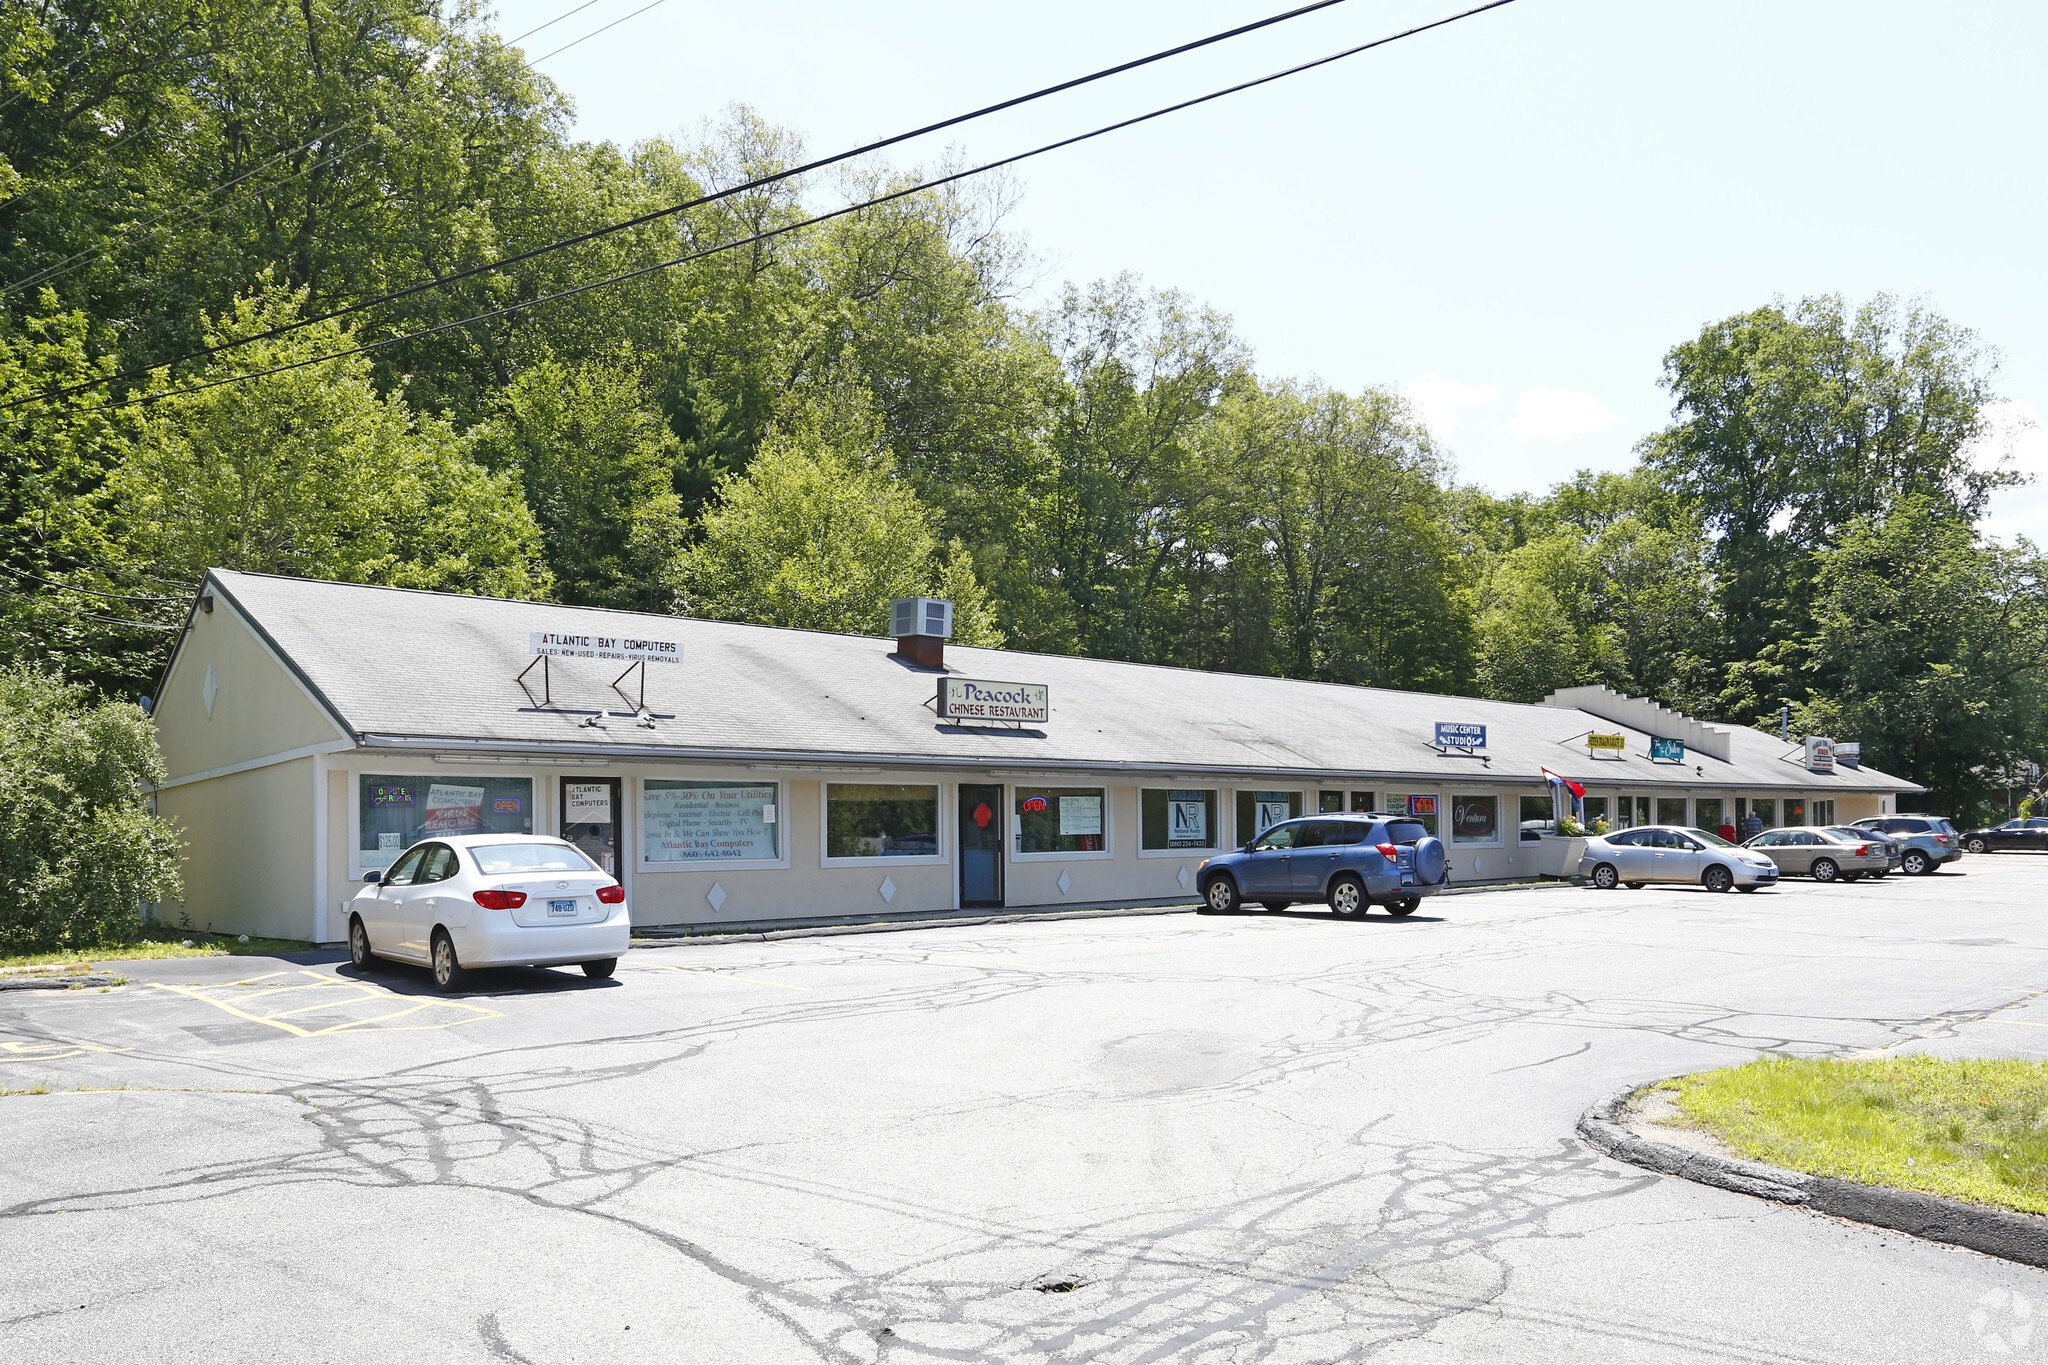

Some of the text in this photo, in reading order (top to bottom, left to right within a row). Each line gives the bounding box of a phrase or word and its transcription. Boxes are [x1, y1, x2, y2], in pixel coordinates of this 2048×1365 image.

[542, 634, 676, 652] ATLANTIC BAY COMPUTERS
[648, 655, 680, 663] REMOVALS
[963, 683, 1032, 704] Peacock
[949, 703, 1045, 718] CHINESE RESTAURANT
[1440, 724, 1481, 734] MUSIC CENTER
[430, 789, 466, 798] ATLANTIC
[702, 791, 715, 799] On
[719, 790, 738, 799] Your
[741, 789, 772, 799] Utilities
[432, 796, 477, 806] COMPUTERS
[496, 801, 520, 811] OPEN
[1023, 800, 1046, 812] OPEN
[1414, 799, 1433, 812] OPEN
[644, 811, 672, 820] elephone
[1176, 803, 1199, 828] NR
[1455, 804, 1486, 825] Ventura
[425, 817, 477, 829] REMOVAL
[660, 820, 680, 829] Digital
[708, 819, 732, 828] Security
[695, 829, 710, 837] Can
[712, 829, 729, 837] Show
[732, 828, 745, 837] You
[746, 828, 760, 836] How
[379, 834, 399, 848] $125.00
[660, 839, 754, 850] Atlantic Bay Computers
